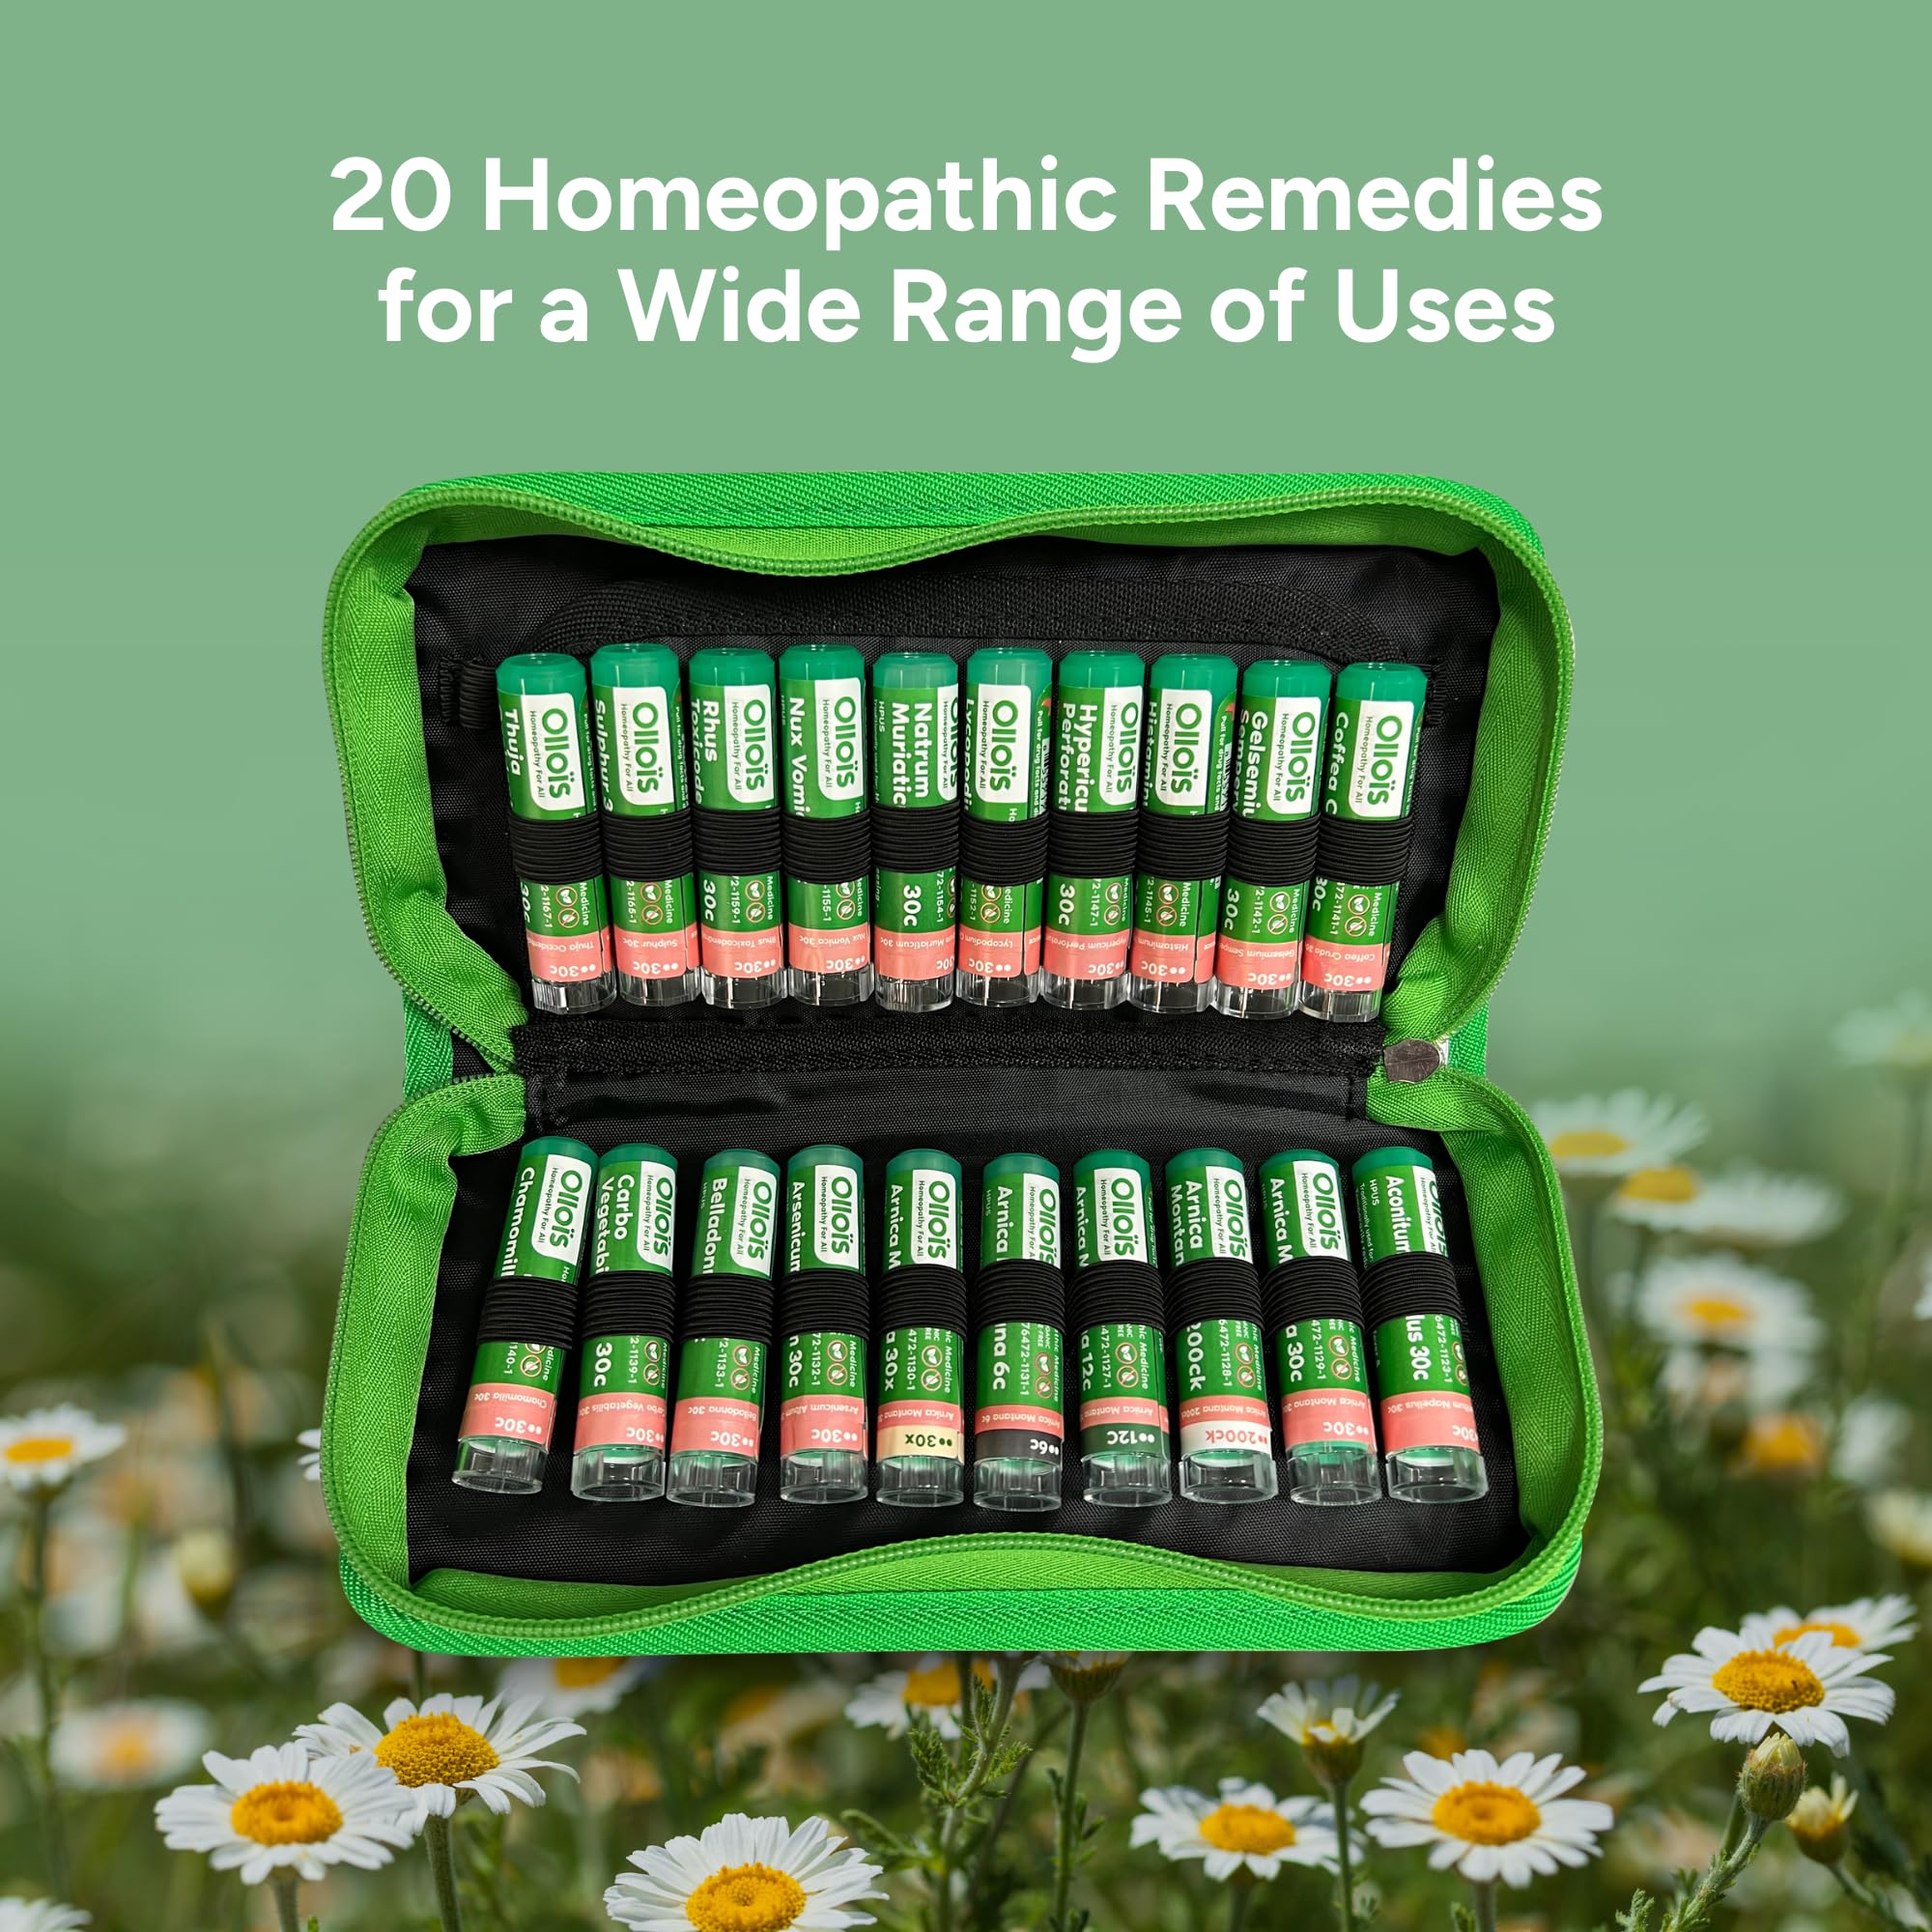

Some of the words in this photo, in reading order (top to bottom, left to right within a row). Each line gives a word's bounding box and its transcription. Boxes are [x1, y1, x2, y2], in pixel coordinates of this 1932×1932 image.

[504, 709, 524, 775] Thuja
[529, 711, 542, 767] Homeopathy
[594, 699, 611, 793] Sulphur
[633, 702, 664, 793] Olloïs
[702, 700, 721, 762] Rhus
[732, 701, 741, 763] Homeopathy
[744, 699, 768, 790] Olloïs
[789, 697, 805, 746] Nux
[834, 696, 858, 788] Olloïs
[915, 703, 932, 798] Natrum
[978, 701, 989, 761] Homeopathy
[989, 699, 1018, 791] Olloïs
[1117, 702, 1139, 793] Olloïs
[1171, 703, 1202, 794] Olloïs
[1328, 712, 1349, 790] Coffea
[1360, 717, 1373, 775] Homeopathy
[533, 771, 543, 784] For
[542, 708, 575, 798] Olloïs
[892, 702, 912, 808] Muriatic
[1144, 702, 1157, 807] Histamin
[1285, 712, 1316, 802] Olloïs
[1367, 715, 1403, 805] Olloïs
[580, 882, 589, 925] Medicine
[703, 880, 717, 922] 30c
[903, 885, 922, 926] 30c
[1059, 884, 1075, 926] 30c
[1179, 882, 1191, 926] Medicine
[1225, 889, 1239, 930] 30c
[1290, 889, 1300, 933] Medicine
[1313, 877, 1327, 912] 30c
[1369, 893, 1381, 936] Medicine
[641, 939, 678, 949] Sulphur
[543, 1168, 558, 1219] Homeopathy
[549, 1170, 582, 1248] Olloïs
[613, 1175, 635, 1240] Carbo
[748, 1181, 773, 1261] Olloïs
[831, 1177, 854, 1255] Olloïs
[890, 1184, 903, 1248] Arnica
[927, 1180, 951, 1260] Olloïs
[996, 1186, 1014, 1253] Arnica
[1076, 1186, 1089, 1249] Arnica
[1100, 1179, 1109, 1229] Homeopathy
[1111, 1178, 1139, 1256] Olloïs
[1185, 1180, 1206, 1249] Arnica
[1224, 1179, 1248, 1258] Olloïs
[1270, 1179, 1290, 1242] Arnica
[1313, 1173, 1342, 1250] Olloïs
[1370, 1179, 1379, 1206] HPUS
[541, 1218, 550, 1230] For
[594, 1343, 612, 1387] 30c
[788, 1350, 803, 1388] 30c
[885, 1349, 898, 1391] 30x
[993, 1362, 1009, 1390] 6c
[1082, 1352, 1094, 1391] 12c
[1140, 1342, 1149, 1389] Medicine
[1287, 1342, 1304, 1382] 30c
[1409, 1346, 1432, 1381] 30c
